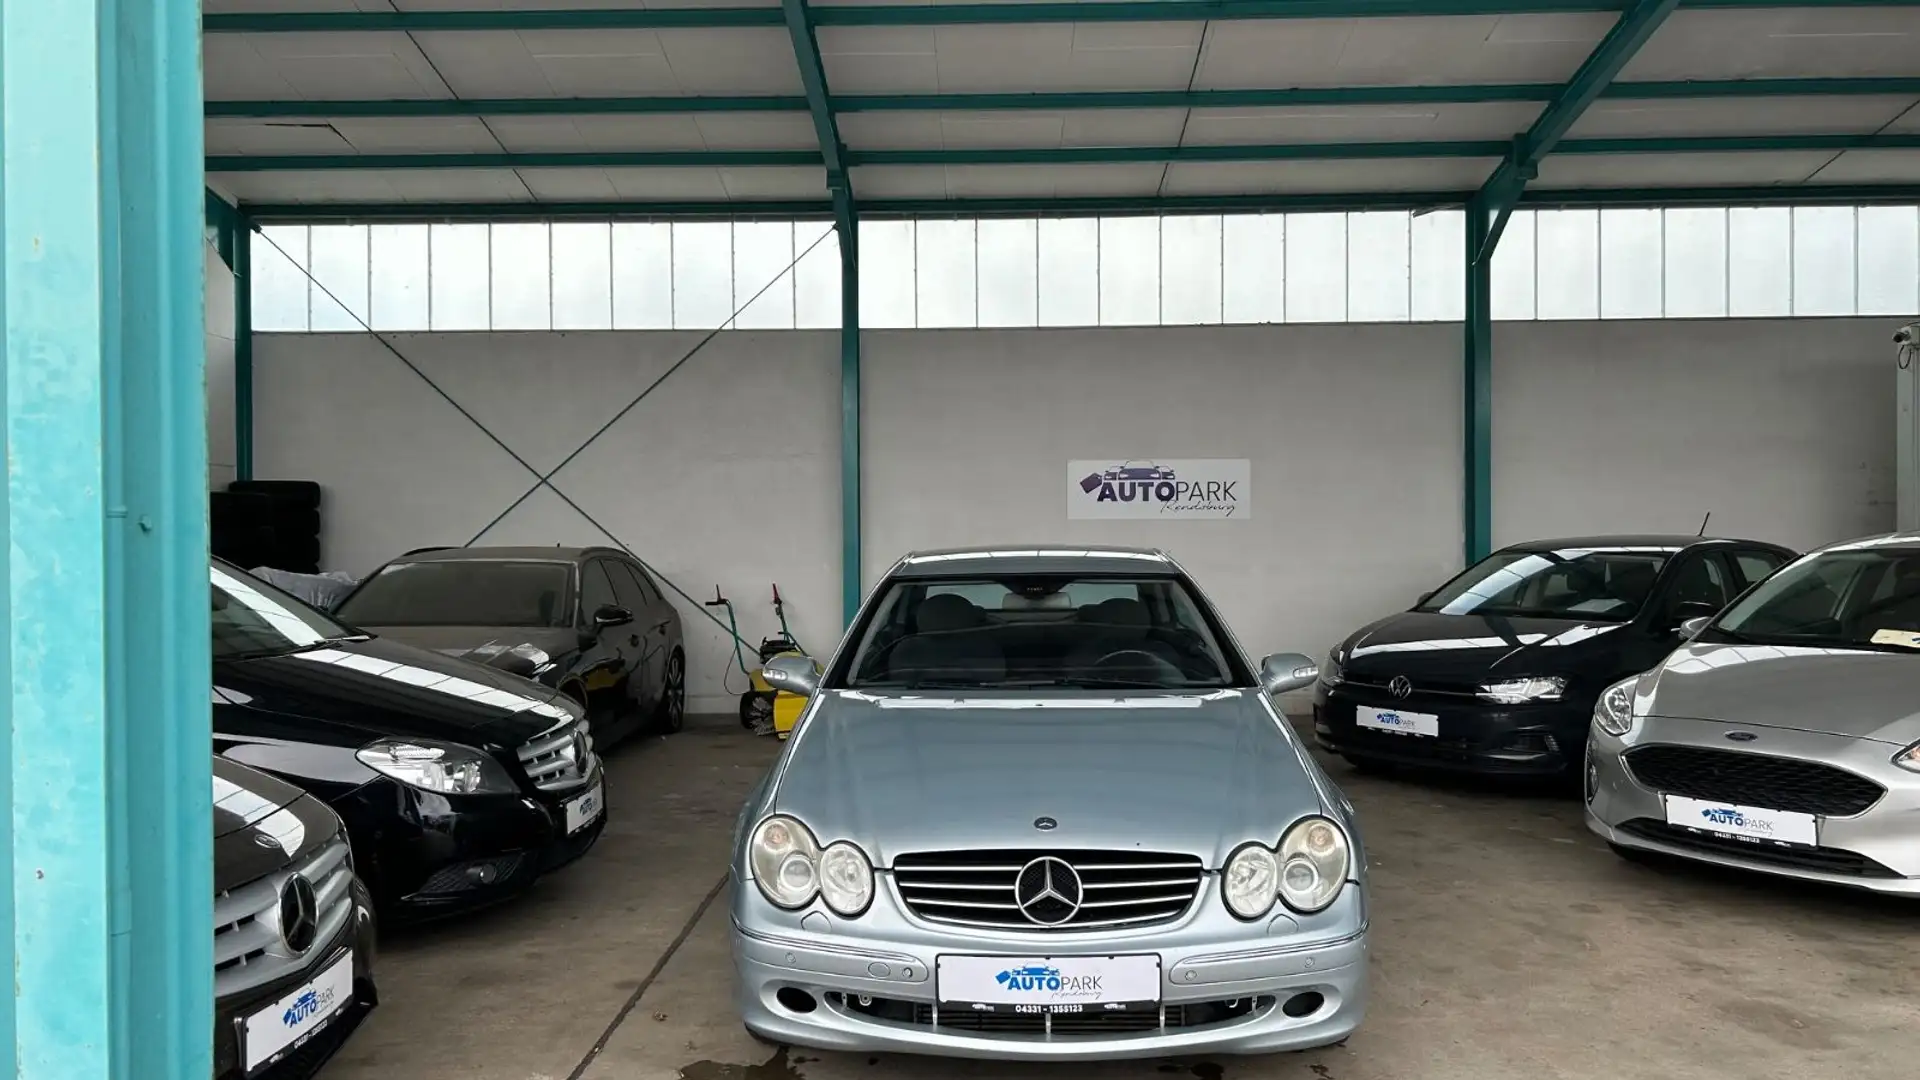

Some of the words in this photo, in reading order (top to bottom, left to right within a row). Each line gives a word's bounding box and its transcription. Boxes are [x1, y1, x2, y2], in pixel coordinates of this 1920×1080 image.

[1097, 481, 1237, 502] AUTOPARK
[1160, 500, 1235, 517] Rendsburg
[1709, 813, 1774, 832] AUTOPARK
[1007, 975, 1103, 991] AUTOPARK
[1015, 1004, 1042, 1014] 04331
